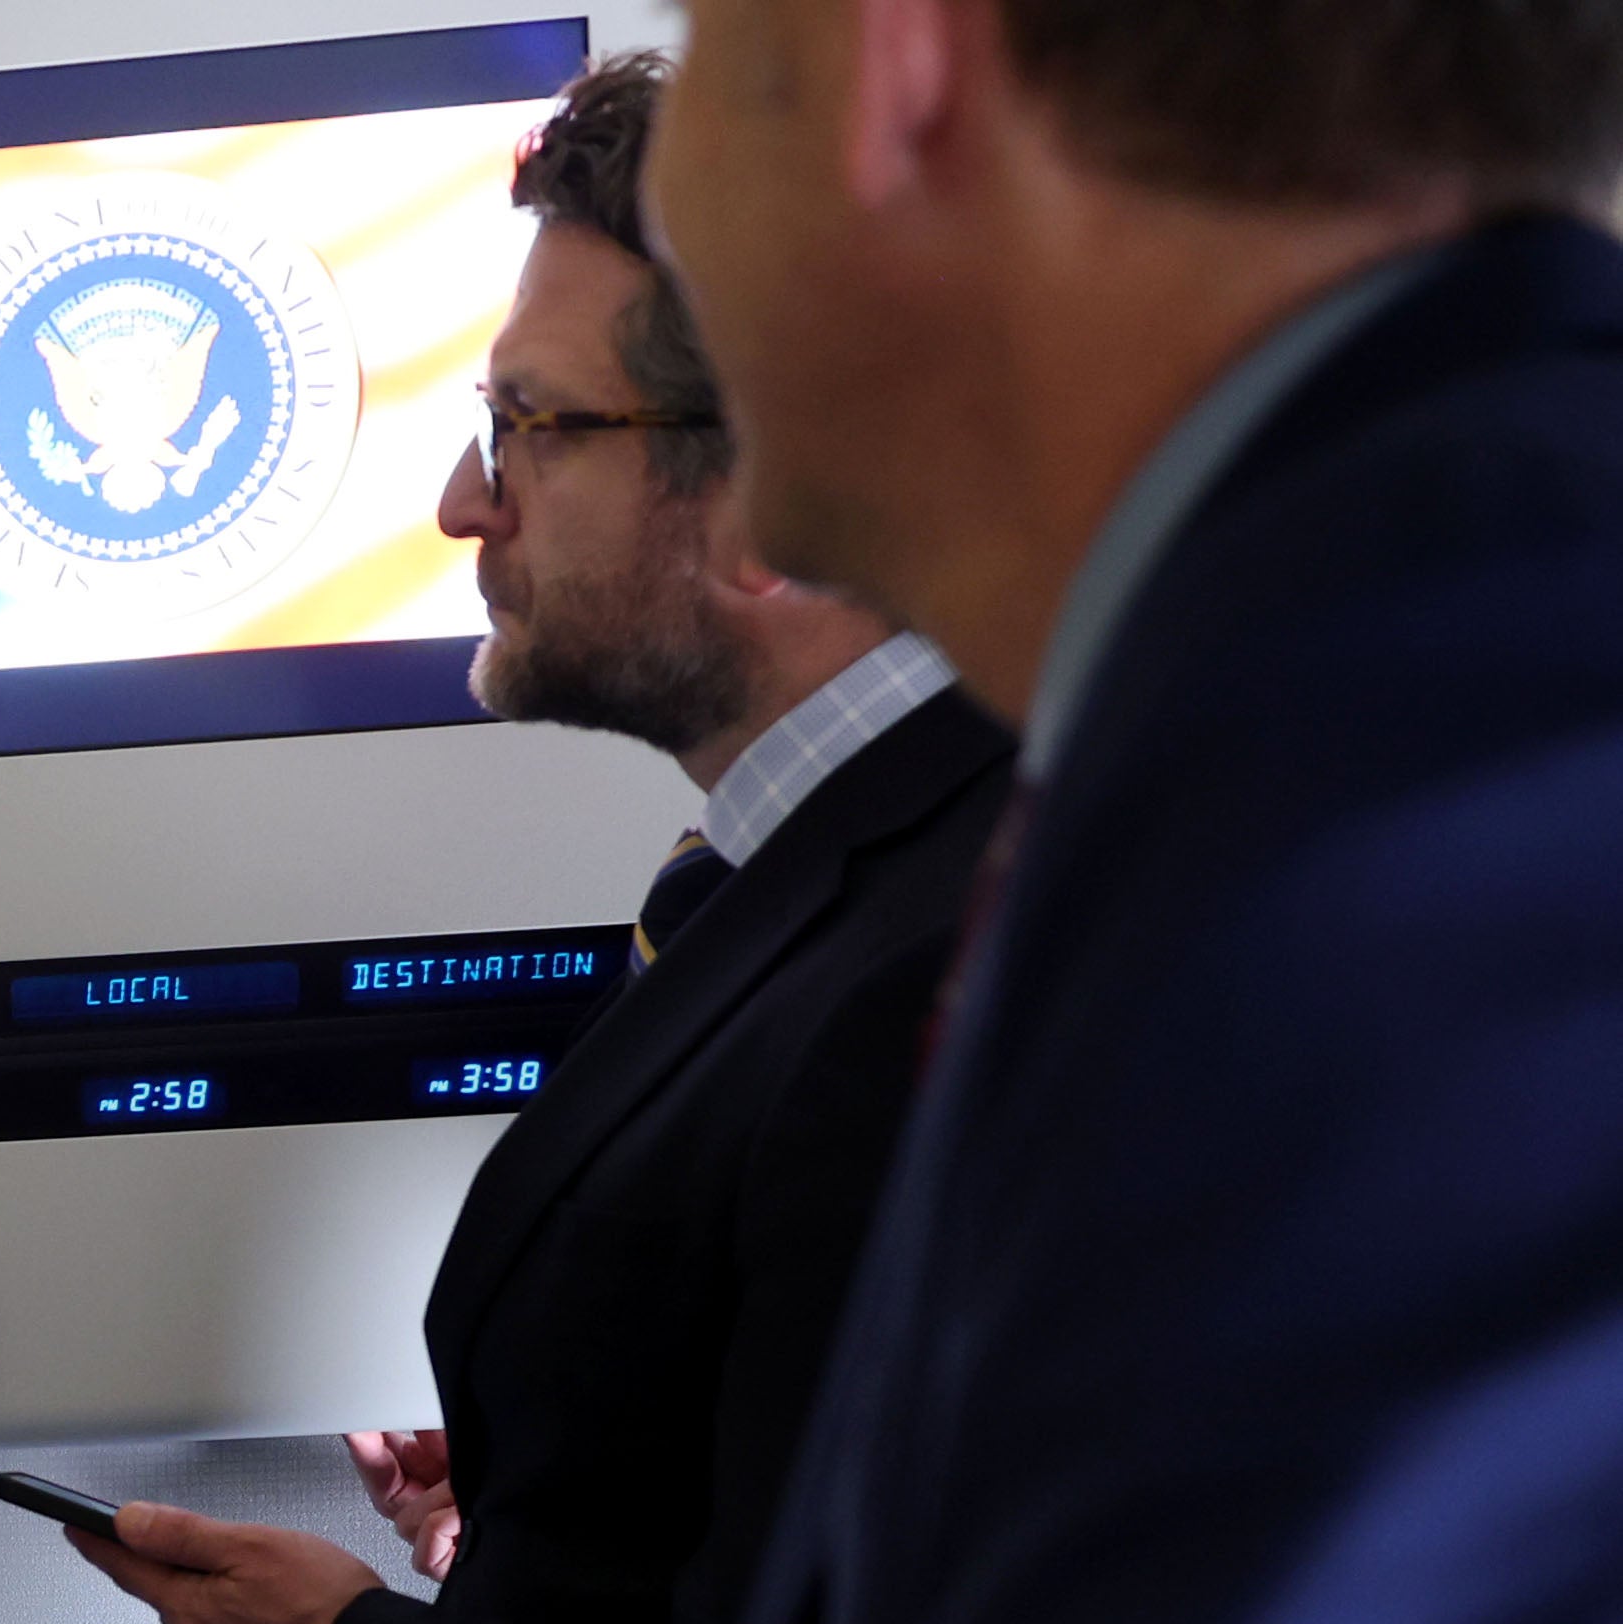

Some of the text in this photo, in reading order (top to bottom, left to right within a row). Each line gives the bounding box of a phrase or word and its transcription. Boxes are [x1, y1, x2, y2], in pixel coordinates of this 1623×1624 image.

[351, 951, 594, 990] DESTINATION
[85, 974, 190, 1005] LOCAL
[429, 1060, 540, 1094] PM 3:58
[99, 1079, 208, 1112] PM 2:58
